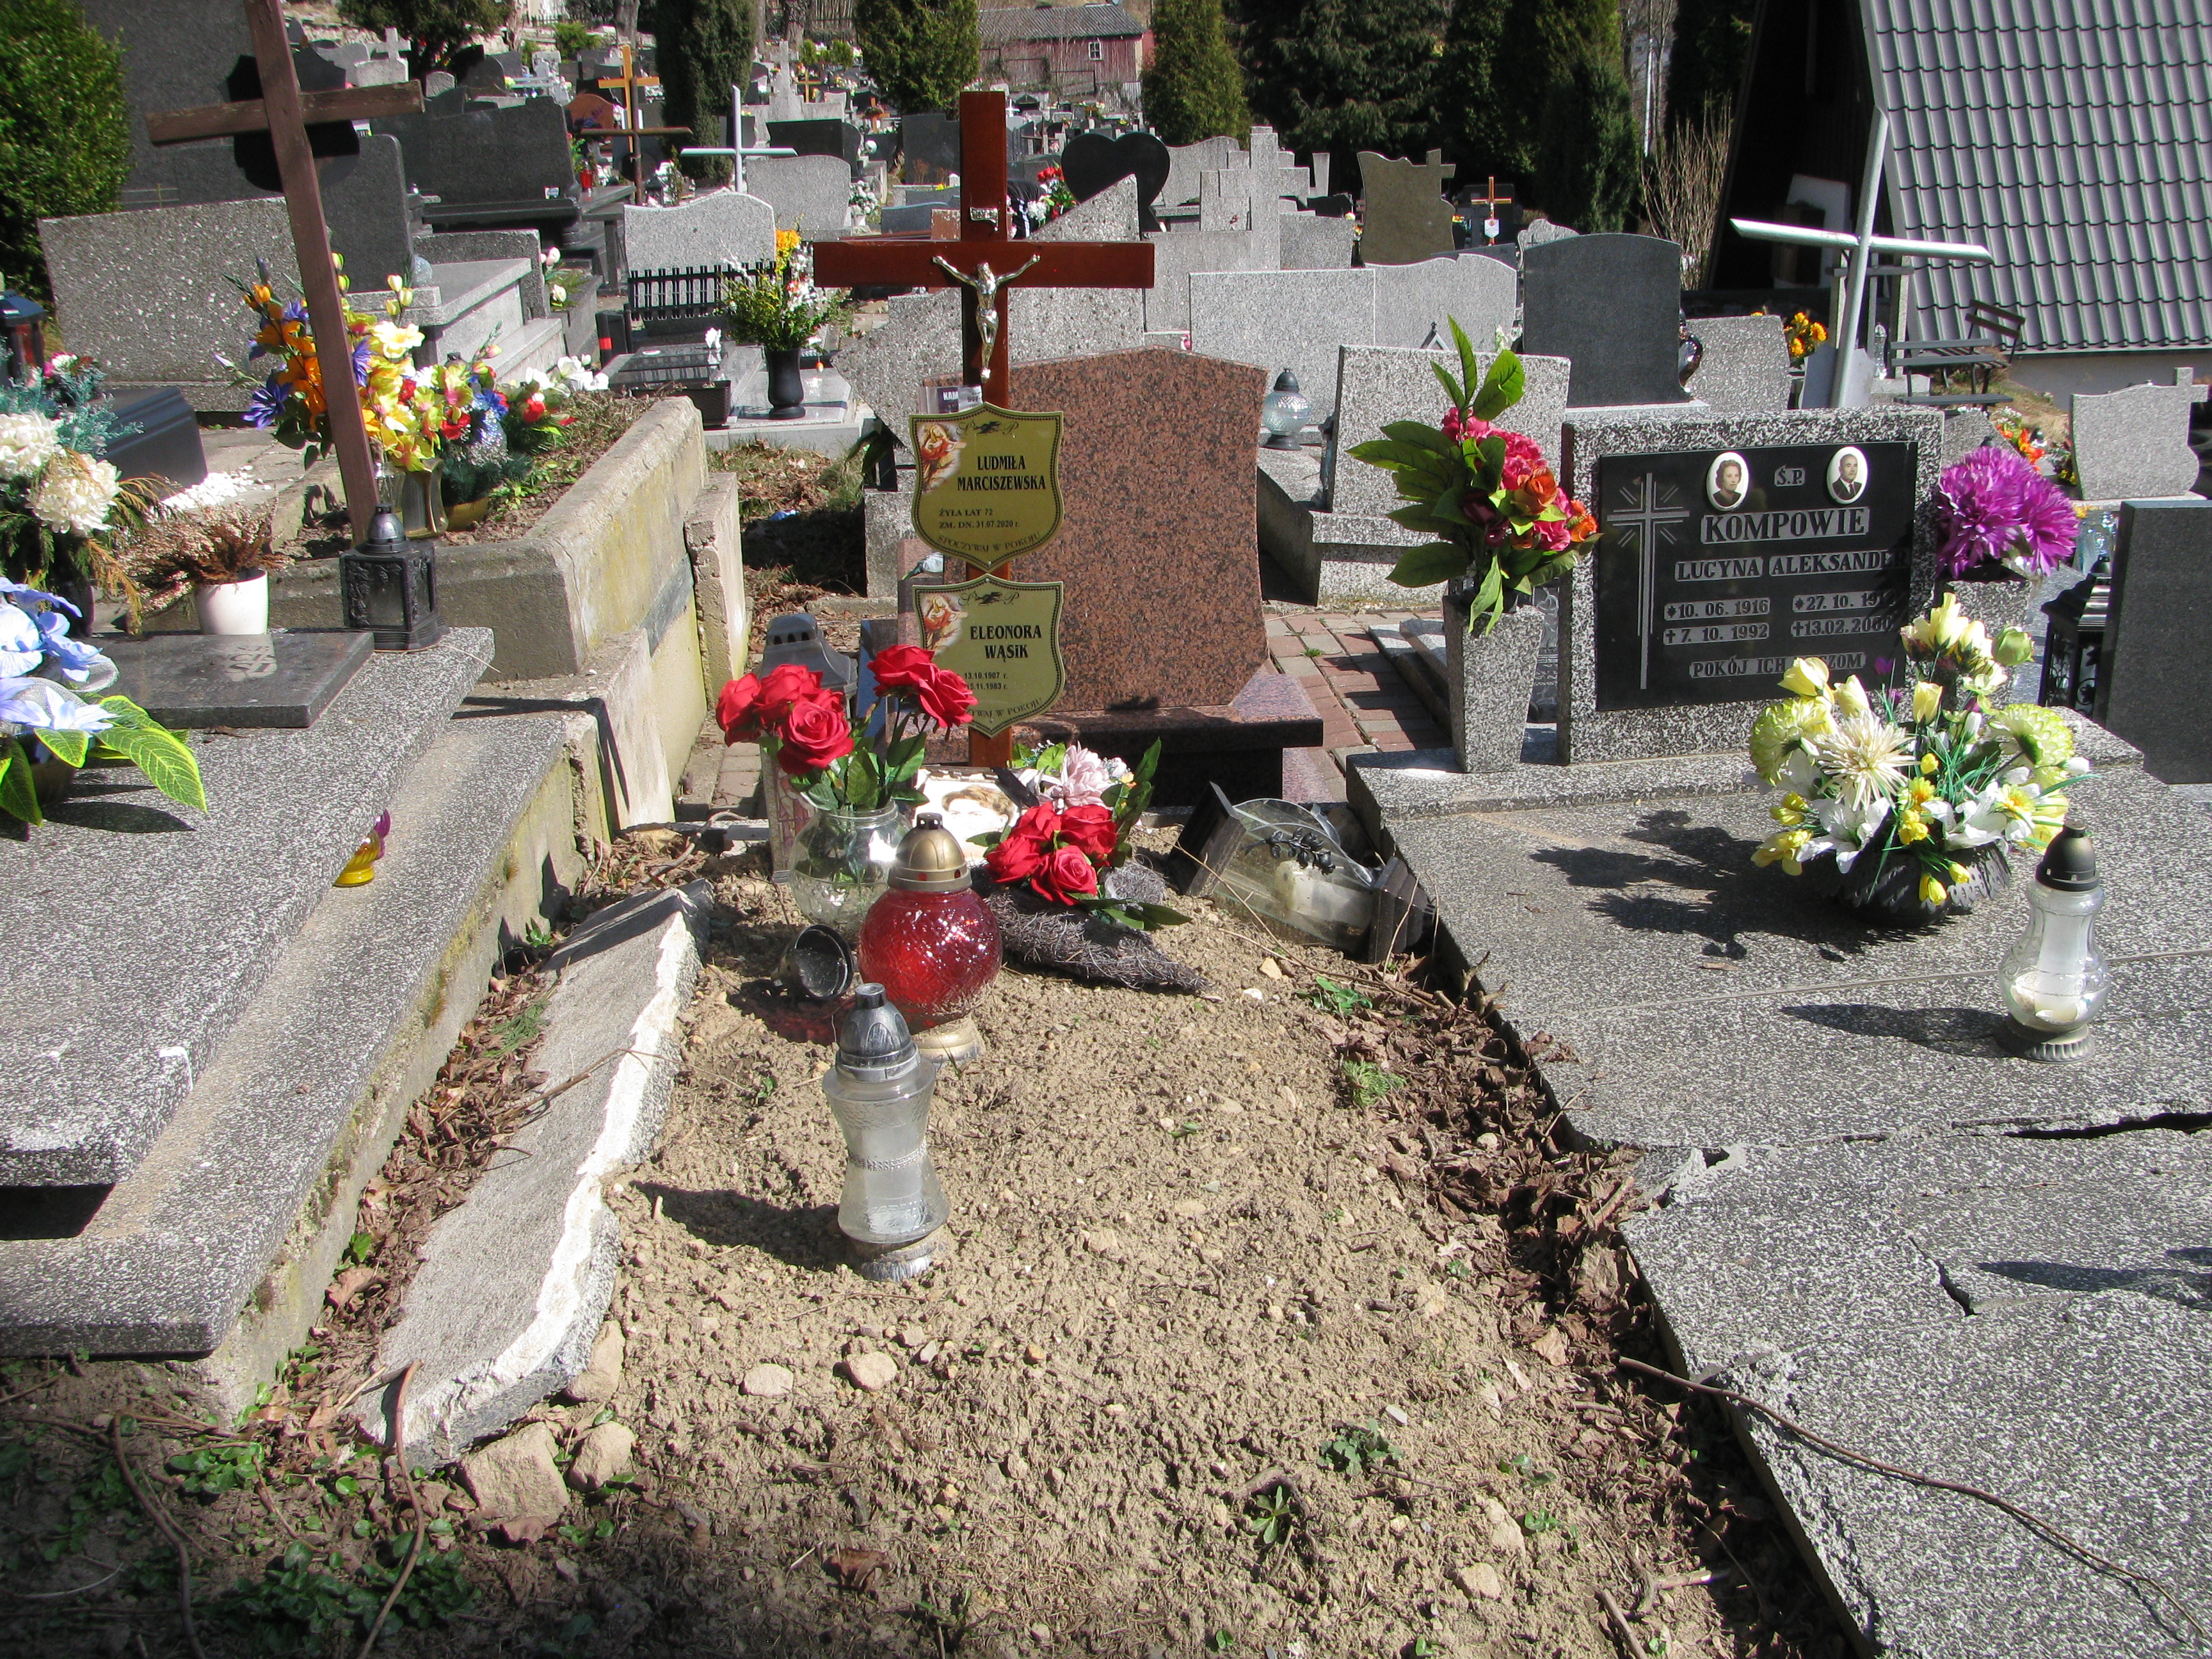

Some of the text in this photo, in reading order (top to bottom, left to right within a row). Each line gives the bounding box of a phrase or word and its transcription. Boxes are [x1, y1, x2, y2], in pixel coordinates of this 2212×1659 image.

[977, 456, 1025, 470] LUDMIŁA
[958, 476, 1046, 491] MARCISZEWSKA
[976, 520, 1013, 528] 31.07.2020
[1705, 508, 1865, 543] KOMPOWIE
[1678, 558, 1760, 581] LUCYNA
[1772, 550, 1907, 575] ALEKSANDER
[1679, 599, 1768, 618] 10. 06. 1916
[1806, 595, 1827, 611] 27.
[1832, 595, 1854, 609] 10.
[970, 625, 1042, 640] ELEONORA
[1702, 627, 1724, 642] 10.
[1731, 624, 1768, 639] 1992
[985, 645, 1029, 662] WĄSIK
[1693, 652, 1863, 677] POKÓJ ICH ZOM
